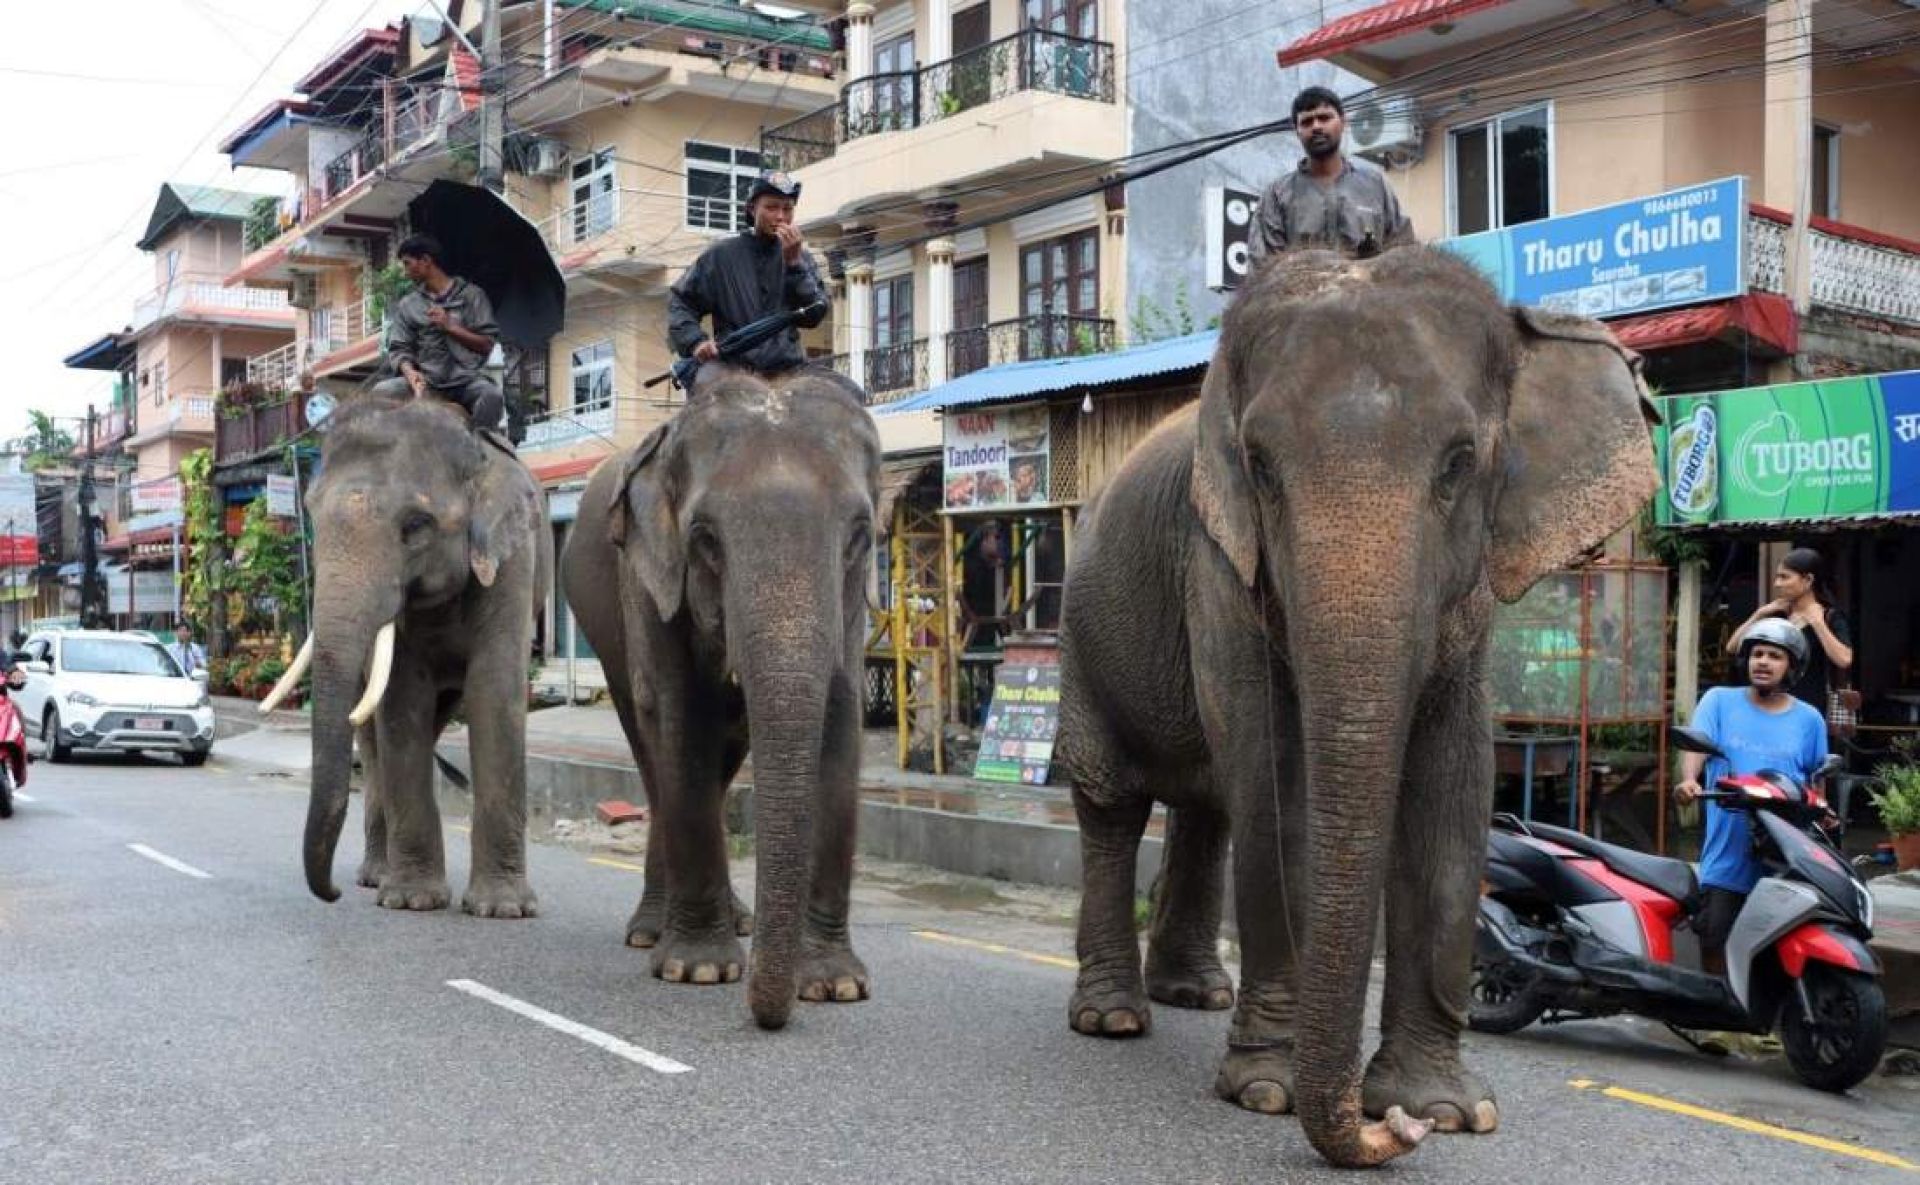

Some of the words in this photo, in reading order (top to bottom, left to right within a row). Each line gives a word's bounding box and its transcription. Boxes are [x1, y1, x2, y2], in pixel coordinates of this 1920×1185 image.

[1522, 238, 1604, 275] Tharu
[1614, 209, 1722, 257] Chulha
[947, 439, 1007, 467] Tandoori
[1674, 428, 1712, 505] TUBORG
[1751, 433, 1873, 477] TUBORG
